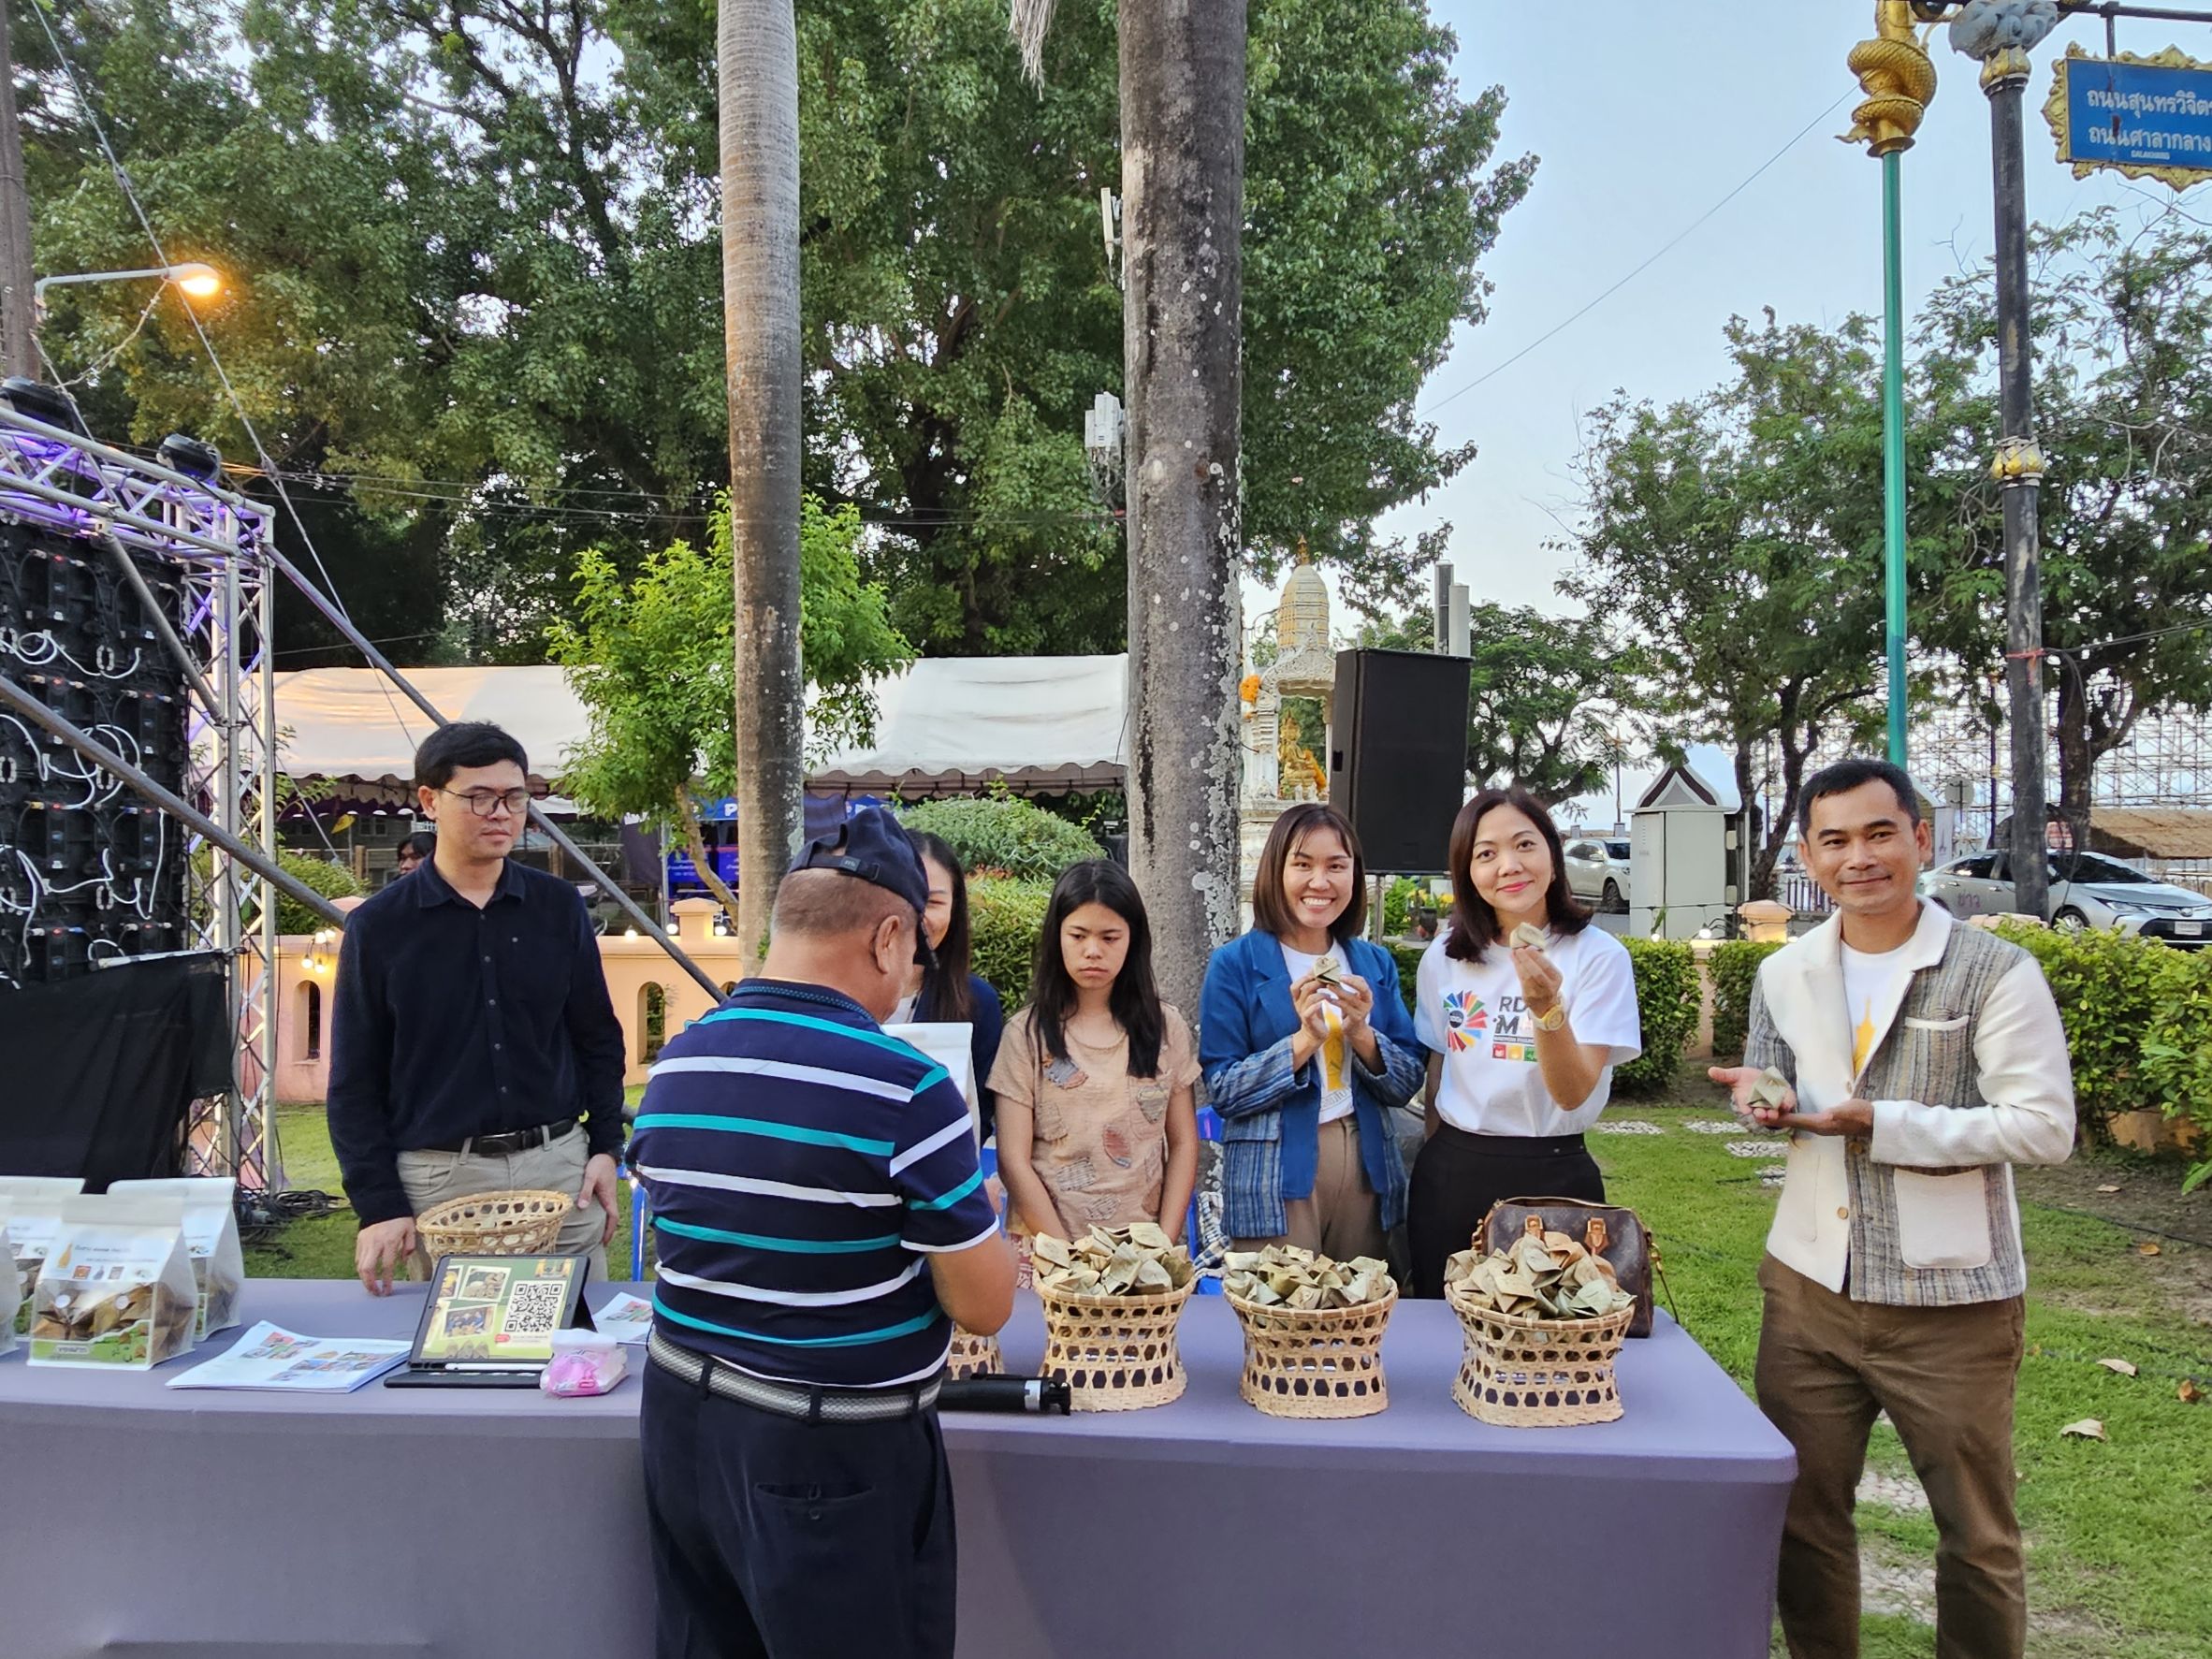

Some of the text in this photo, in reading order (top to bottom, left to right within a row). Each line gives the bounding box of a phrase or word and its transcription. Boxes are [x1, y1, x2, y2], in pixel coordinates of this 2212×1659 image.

[2087, 89, 2212, 119] ถนนสุนทรวิจิต
